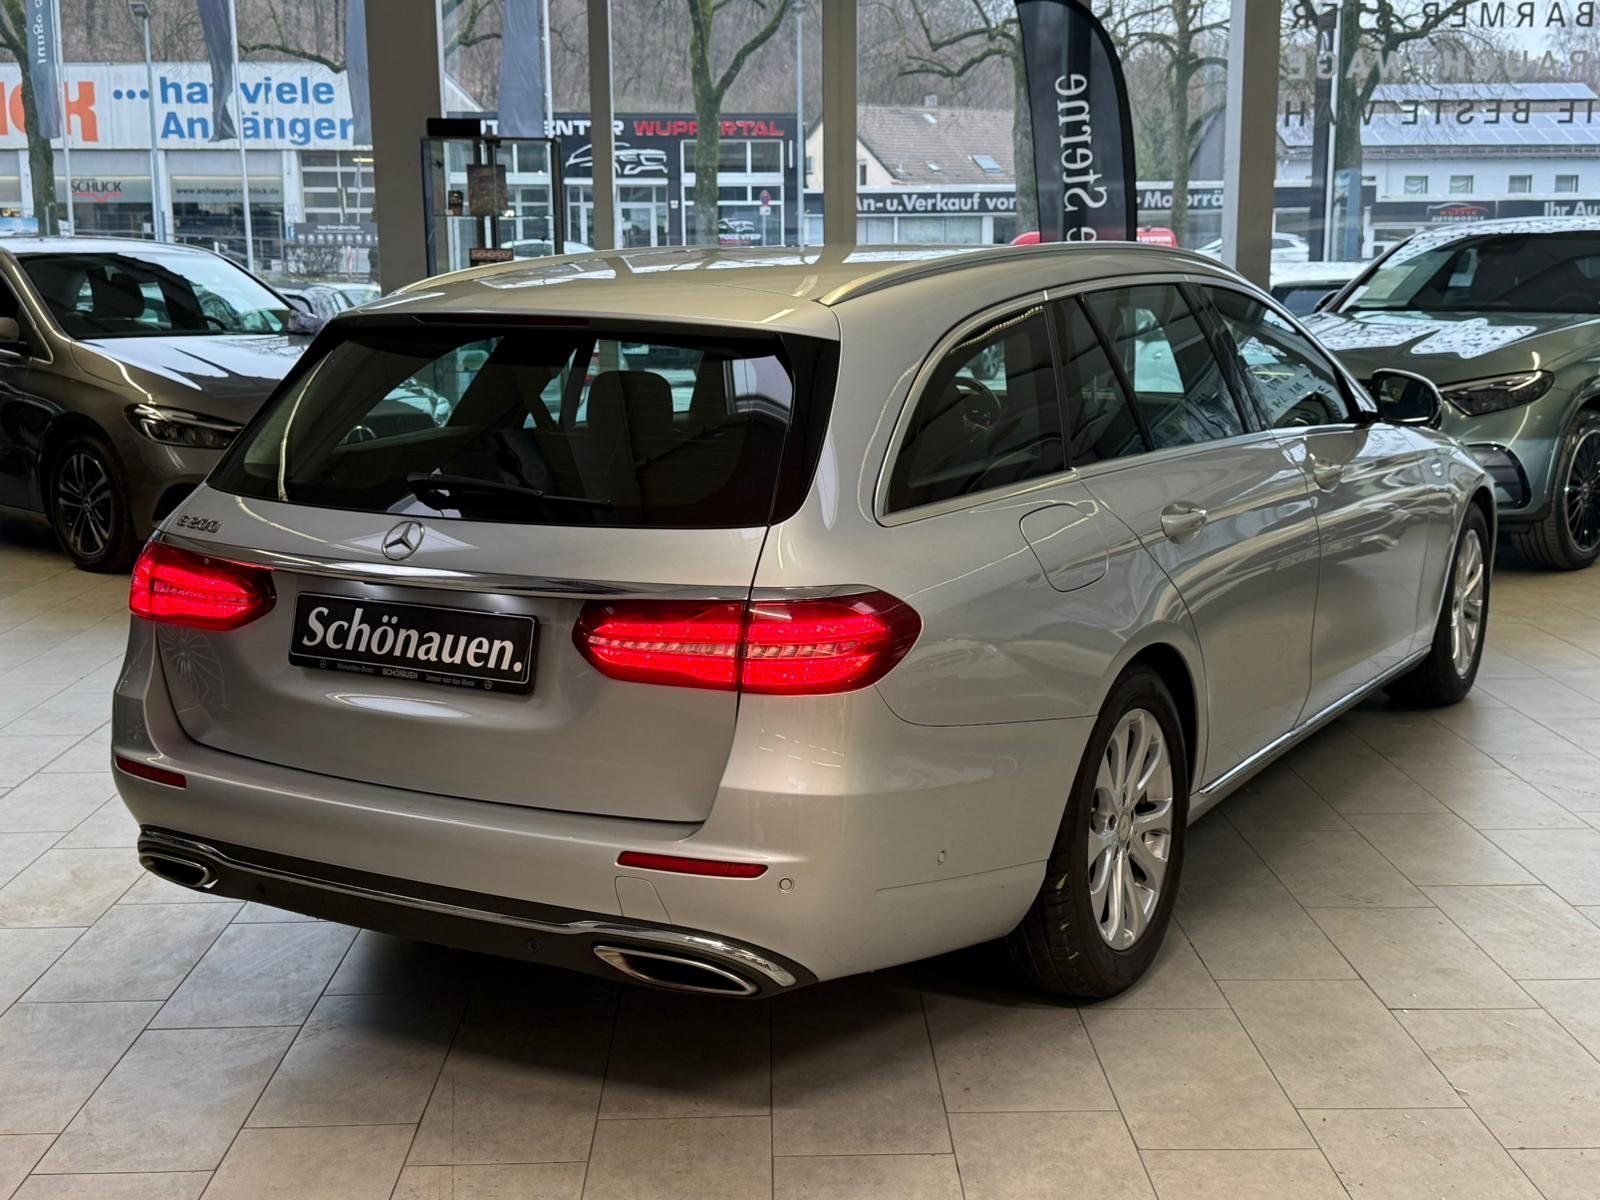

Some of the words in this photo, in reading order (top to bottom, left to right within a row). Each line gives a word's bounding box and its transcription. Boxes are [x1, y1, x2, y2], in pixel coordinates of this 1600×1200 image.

[159, 76, 213, 105] ha
[240, 76, 335, 105] viele
[160, 111, 354, 146] Anänger
[633, 120, 785, 137] WUPPRTAL
[1544, 200, 1570, 217] Ihr
[1573, 200, 1600, 217] Au
[302, 606, 523, 673] Schönauen.
